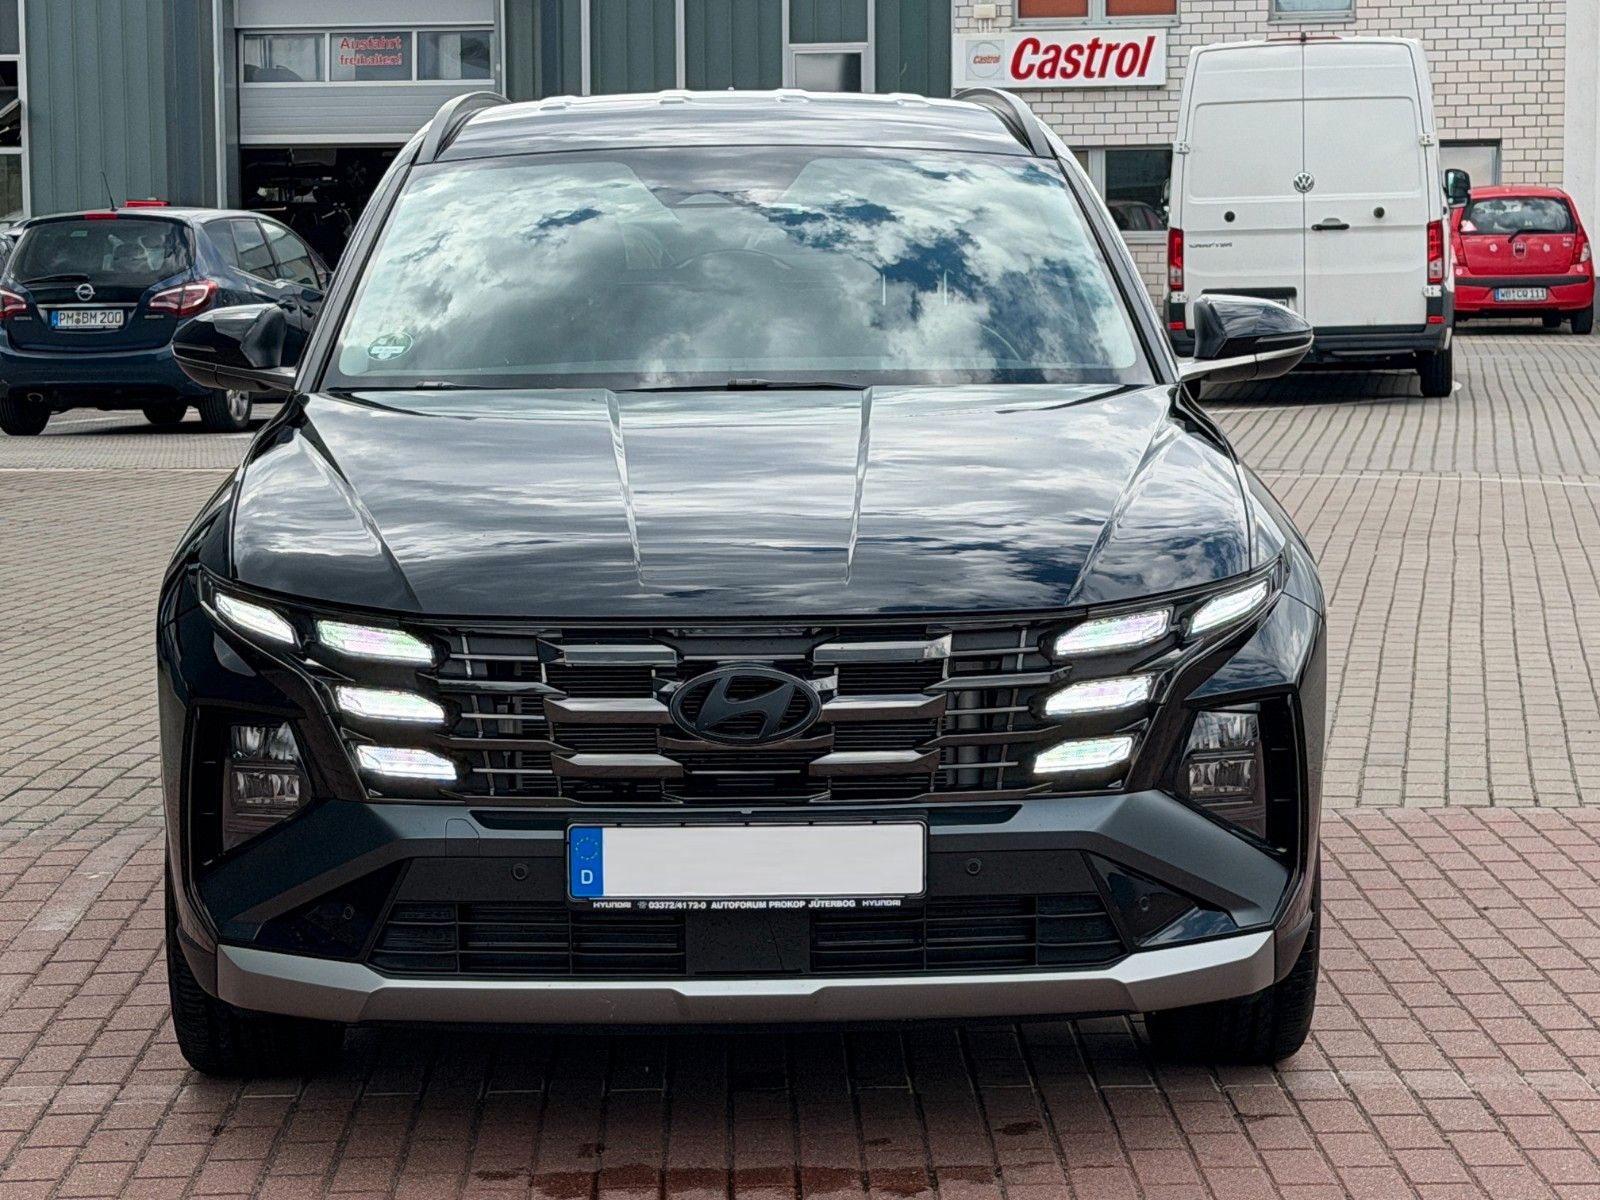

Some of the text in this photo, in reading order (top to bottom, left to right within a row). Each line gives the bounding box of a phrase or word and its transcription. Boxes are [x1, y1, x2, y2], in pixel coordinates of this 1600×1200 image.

[973, 55, 1000, 64] Castrol
[1010, 36, 1156, 80] Castrol
[100, 311, 122, 324] 200
[581, 869, 593, 885] D
[593, 901, 632, 909] HYUNDAI
[711, 900, 767, 909] AUTOFORUM
[769, 900, 806, 909] PROKOP
[862, 899, 902, 907] HYUNDAI
